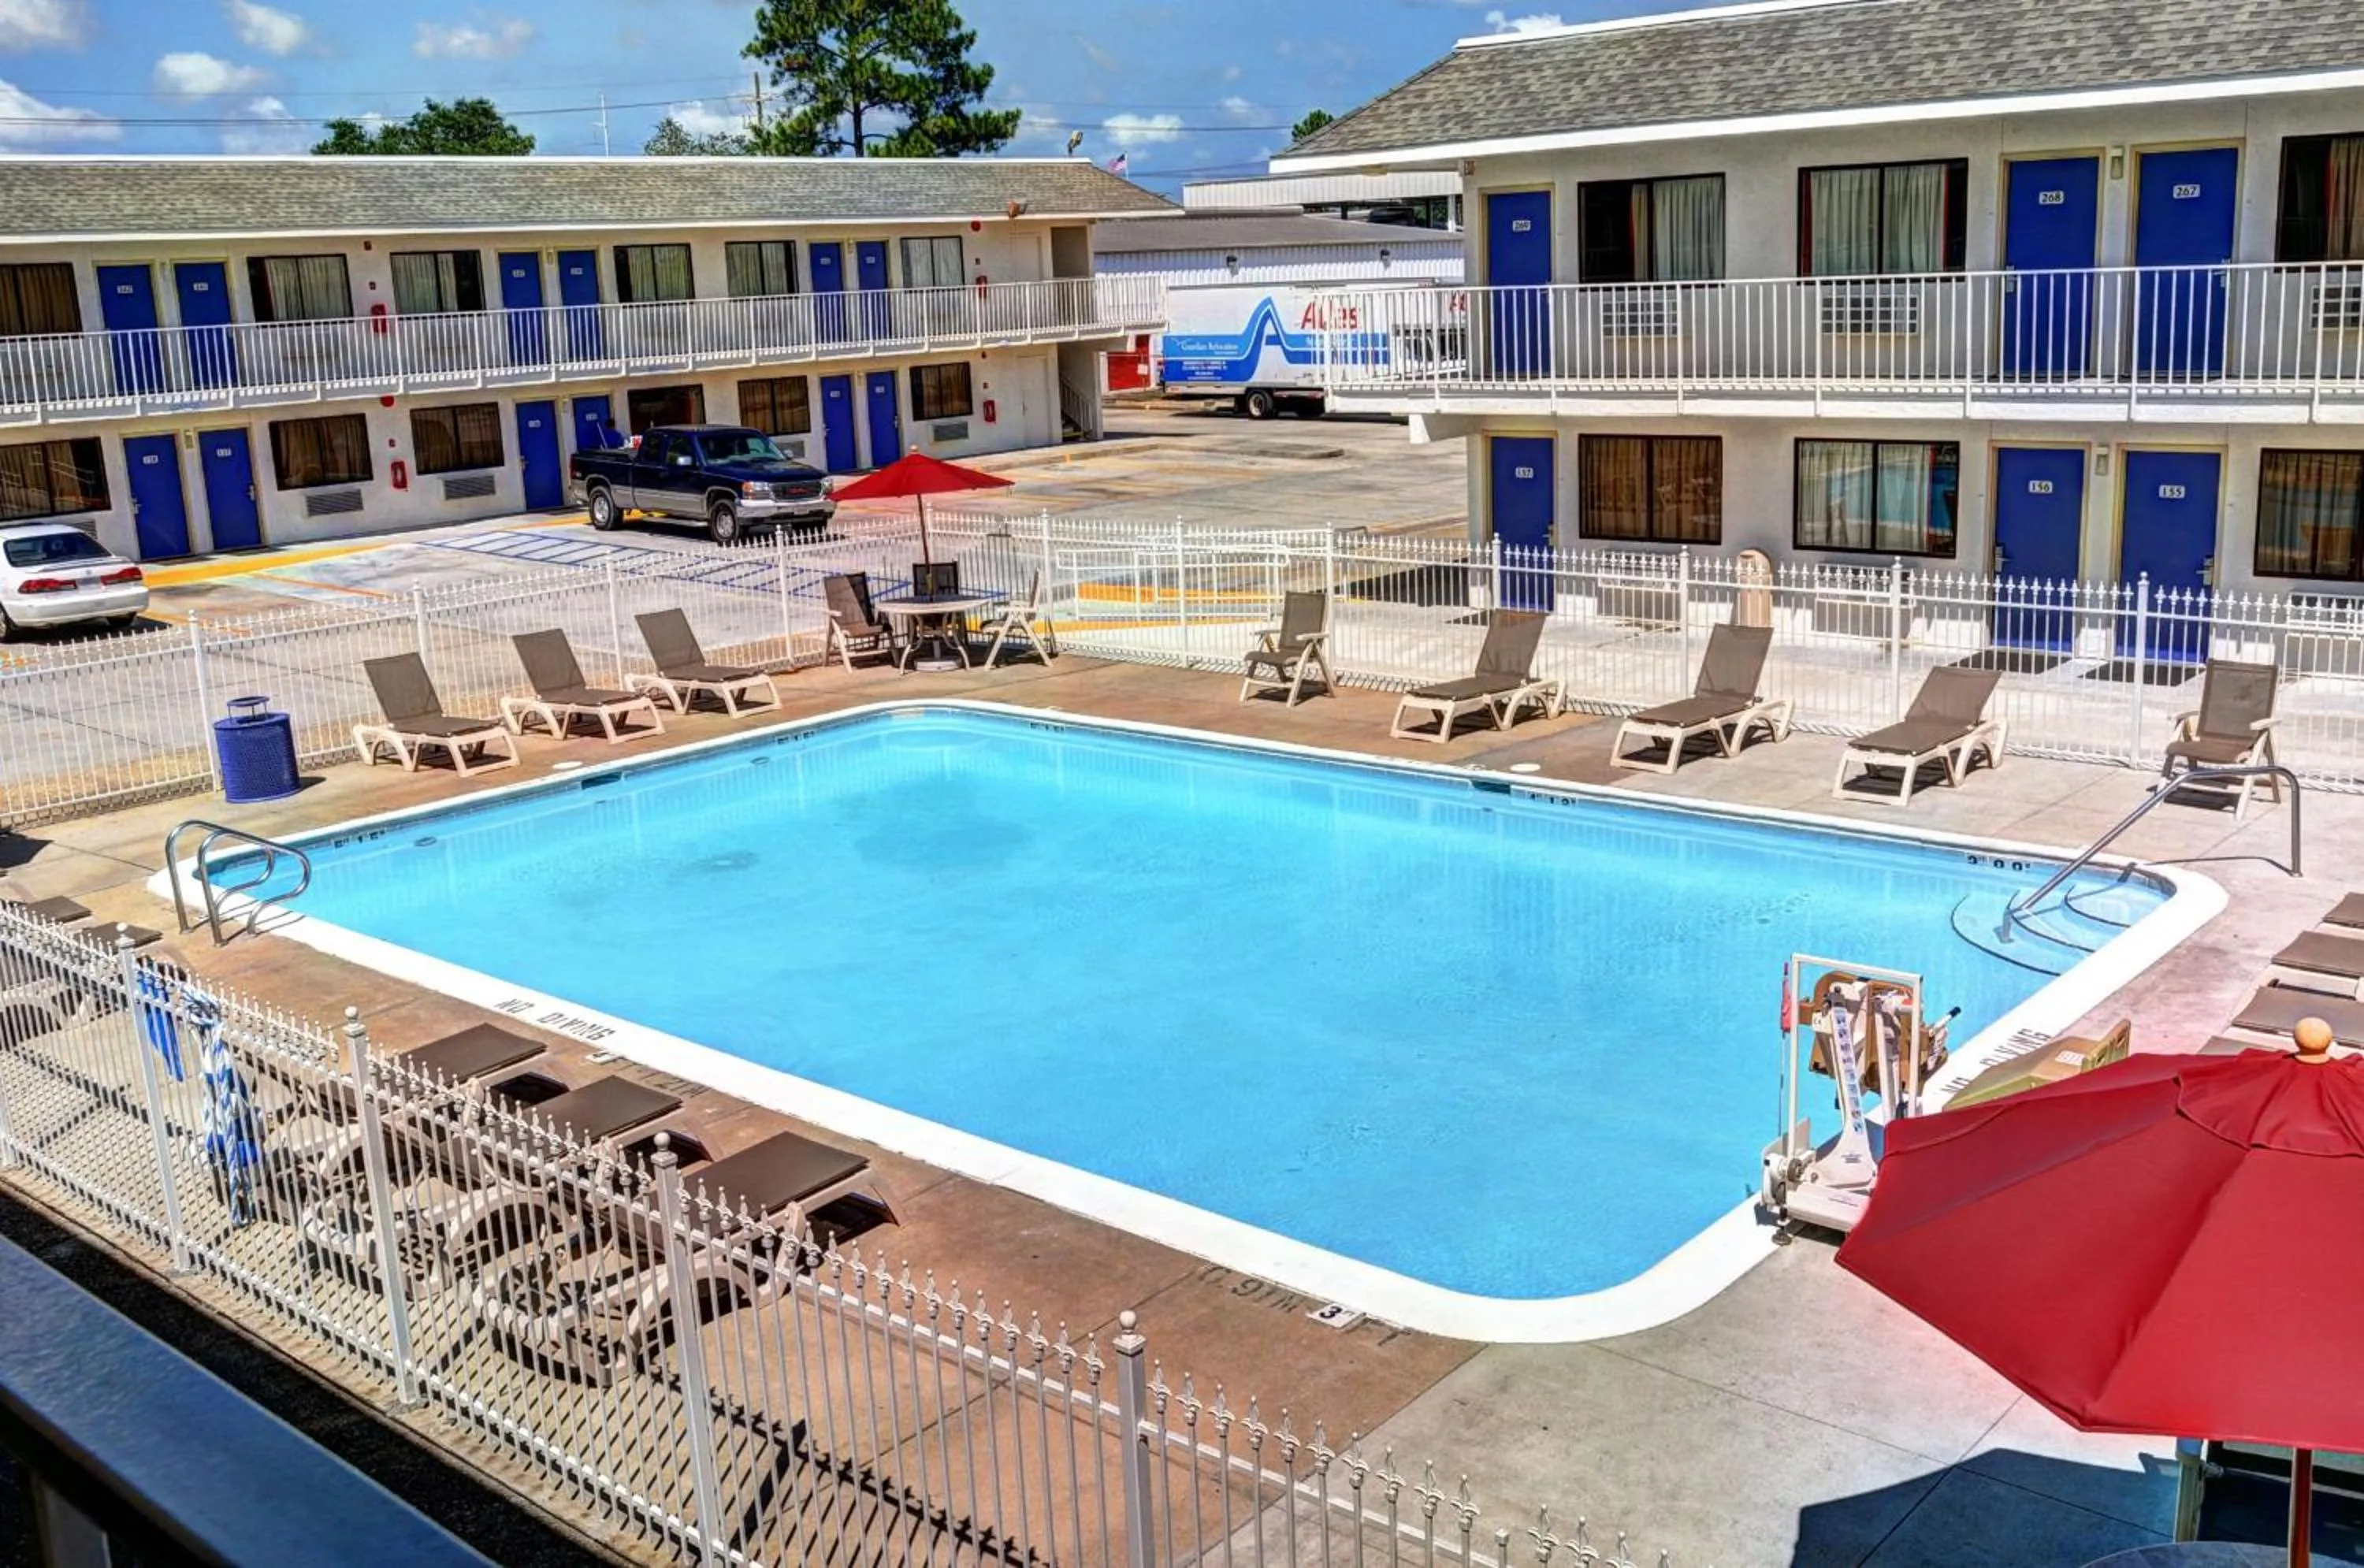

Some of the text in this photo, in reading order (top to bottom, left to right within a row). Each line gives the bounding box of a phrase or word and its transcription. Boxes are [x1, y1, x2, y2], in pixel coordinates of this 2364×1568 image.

[2041, 191, 2062, 203] 268
[2175, 185, 2197, 197] 267
[2031, 481, 2050, 492] 156
[2161, 485, 2182, 497] 155
[494, 998, 616, 1041] NO DIVING
[1940, 1076, 1970, 1094] NO
[1979, 1027, 2052, 1067] DIVING
